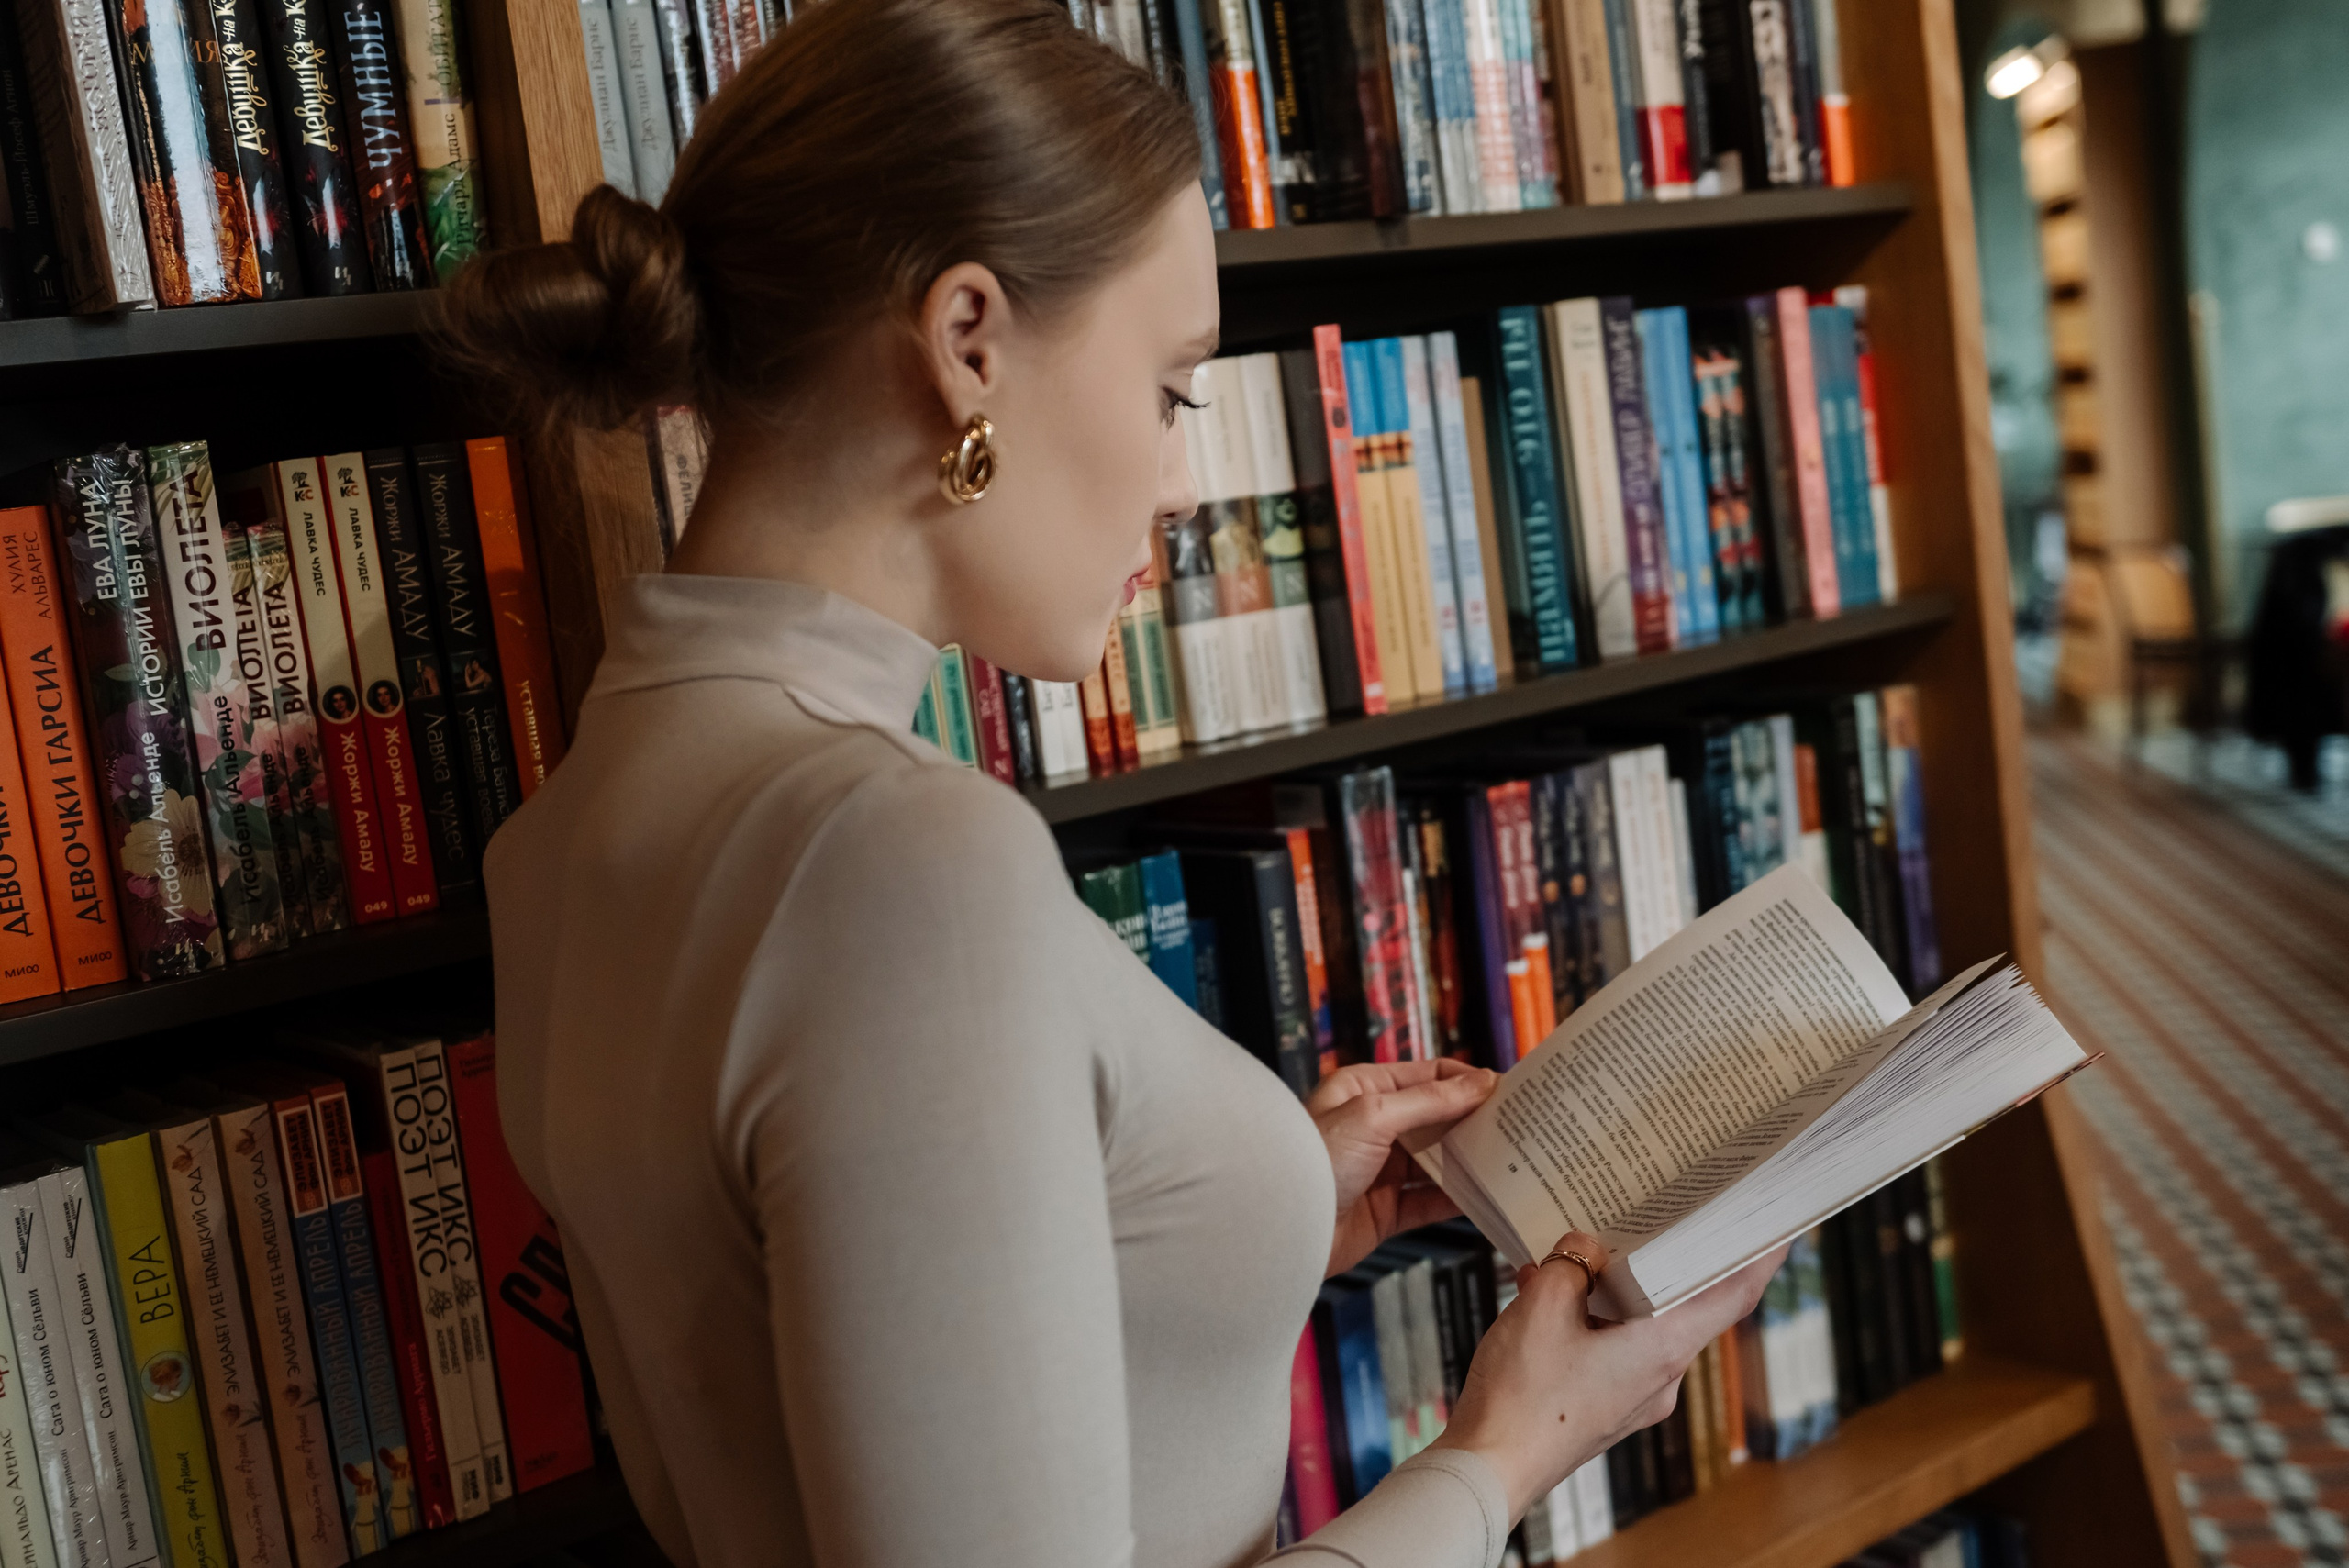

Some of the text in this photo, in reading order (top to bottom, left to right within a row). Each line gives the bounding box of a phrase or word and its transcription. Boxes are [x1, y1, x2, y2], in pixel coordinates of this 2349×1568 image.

[291, 17, 306, 39] на
[283, 38, 342, 156] Девушка
[342, 6, 405, 170] ЧУМНЫЕ
[584, 17, 617, 153] Джулиан Барнс
[622, 16, 658, 152] Джулиан Барнс
[0, 68, 39, 226] Шмуэль-Йосеф Агнон
[438, 112, 475, 246] Ричард Адамс
[0, 532, 26, 595] ХУЛИЯ
[22, 528, 53, 621] АЛЬВАРЕС
[77, 479, 119, 601] ЕВА ЛУНА
[167, 468, 227, 652] ВИОЛЕТА
[301, 510, 327, 597] ЛАВКА ЧУДЕС
[346, 506, 372, 593] ЛАВКА ЧУДЕС
[112, 477, 170, 717] ИСТОРИИ ЕВЫ ЛУНЫ
[390, 545, 430, 644] АМАДУ
[438, 541, 477, 640] АМАДУ
[230, 584, 273, 722] ВИОЛЕТА
[263, 579, 306, 715] ВИОЛЕТА
[28, 643, 73, 766] ГАРСИА
[462, 706, 488, 783] уставшая
[479, 703, 505, 762] Тереза
[518, 679, 542, 761] уставшая
[135, 730, 187, 925] Исабель Альенде
[207, 693, 263, 906] Исабель Альенде
[257, 751, 287, 828] Альенде
[289, 744, 331, 903] Исабель Альенде
[338, 730, 377, 873] Жоржи Амаду
[382, 725, 420, 867] Жоржи Амаду
[422, 709, 465, 862] Лавка чудес
[50, 773, 106, 928] ДЕВОЧКИ
[362, 899, 388, 915] 049
[405, 892, 431, 907] 049
[1637, 1089, 1687, 1152] рубина, большие
[1717, 1100, 1741, 1129] лежали
[1724, 1073, 1749, 1105] комната
[1727, 1061, 1759, 1100] сказочный
[284, 1115, 309, 1192] ЭЛИЗАБЕТ
[294, 1111, 322, 1190] фон АРНИМ
[319, 1100, 346, 1178] ЭЛИЗАБЕТ
[330, 1098, 357, 1176] фон АРНИМ
[385, 1062, 449, 1279] ПОЭТ ИКС
[416, 1053, 473, 1266] ПОЭТ ИКС
[1556, 1151, 1601, 1210] уборка; поэтому
[1578, 1144, 1599, 1170] всегда
[1585, 1137, 1630, 1195] мистер Рочестер
[1612, 1141, 1636, 1170] думать,
[1623, 1140, 1643, 1162] пыли,
[1561, 1173, 1581, 1195] будут
[1569, 1150, 1615, 1212] когда находит
[125, 1234, 177, 1325] ВЕРА
[185, 1166, 242, 1396] ЭЛИЗАБЕТ И ЕЕ НЕМЕЦКИЙ САД
[247, 1149, 303, 1377] ЭЛИЗАБЕТ И ЕЕ НЕМЕЦКИЙ САД
[24, 1287, 68, 1437] Сага о юном Сёльви
[72, 1272, 116, 1419] Сага о юном Сёльви
[296, 1216, 369, 1453] ЗАЧАРОВАННЫЙ АПРЕЛЬ
[332, 1200, 404, 1439] ЗАЧАРОВАННЫЙ АПРЕЛЬ
[434, 1328, 451, 1376] АСЕВЕДО
[444, 1325, 462, 1376] ЭЛИЗАБЕТ
[469, 1312, 485, 1362] ЭЛИЗАБЕТ
[403, 1340, 427, 1394] Арриага
[104, 1429, 140, 1551] Арнар Маур Арнгримсон
[166, 1451, 197, 1496] Арним
[181, 1494, 203, 1521] фон
[466, 1468, 481, 1501] МИФ
[67, 1509, 87, 1539] Маур
